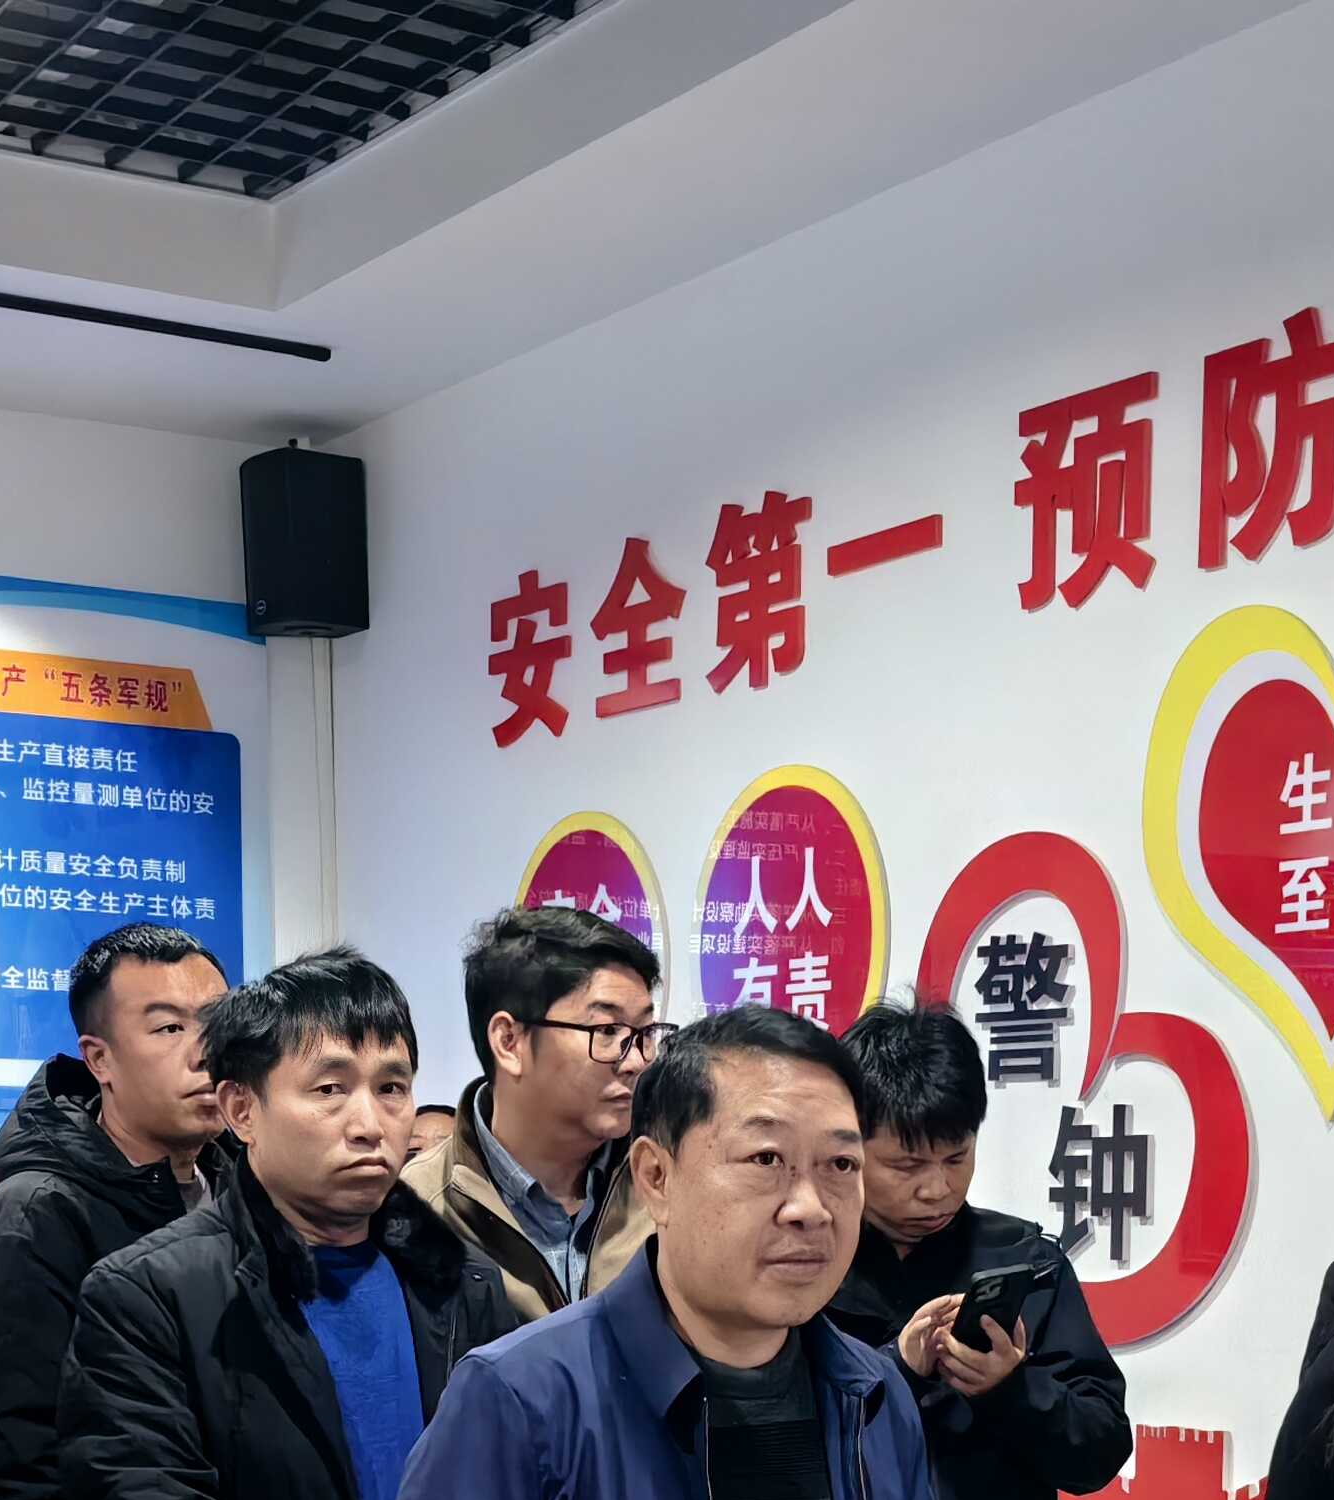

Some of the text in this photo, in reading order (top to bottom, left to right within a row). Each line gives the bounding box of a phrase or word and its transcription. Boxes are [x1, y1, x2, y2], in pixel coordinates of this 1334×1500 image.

[488, 491, 942, 748] 安全第一
[733, 847, 833, 934] 人人
[733, 951, 833, 1030] 有责
[976, 932, 1074, 1088] 警
[1048, 1105, 1152, 1267] 钟
